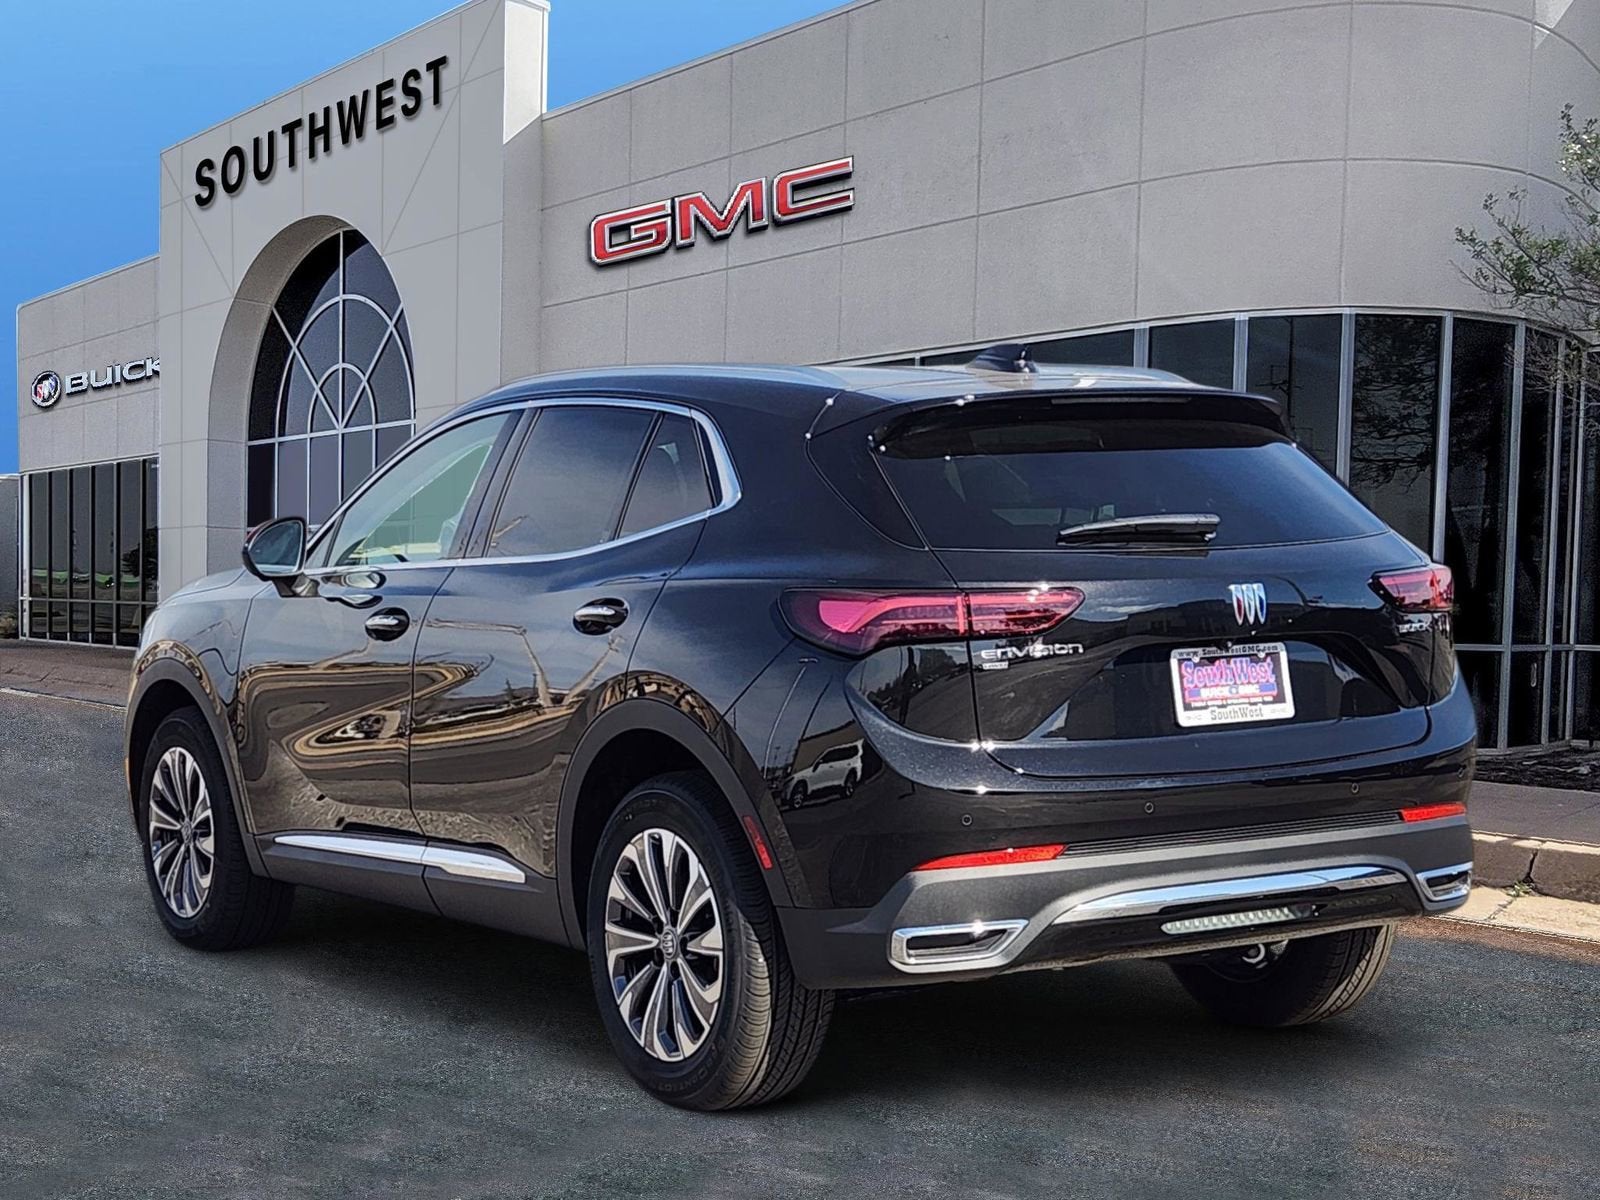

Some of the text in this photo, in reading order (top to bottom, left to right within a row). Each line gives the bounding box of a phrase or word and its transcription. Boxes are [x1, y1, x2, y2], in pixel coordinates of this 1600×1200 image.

[194, 55, 448, 208] SOUTHWEST
[590, 155, 855, 266] GMC
[64, 357, 159, 395] BUICK
[1181, 656, 1276, 688] SouthWest
[1210, 704, 1264, 721] SouthWest
